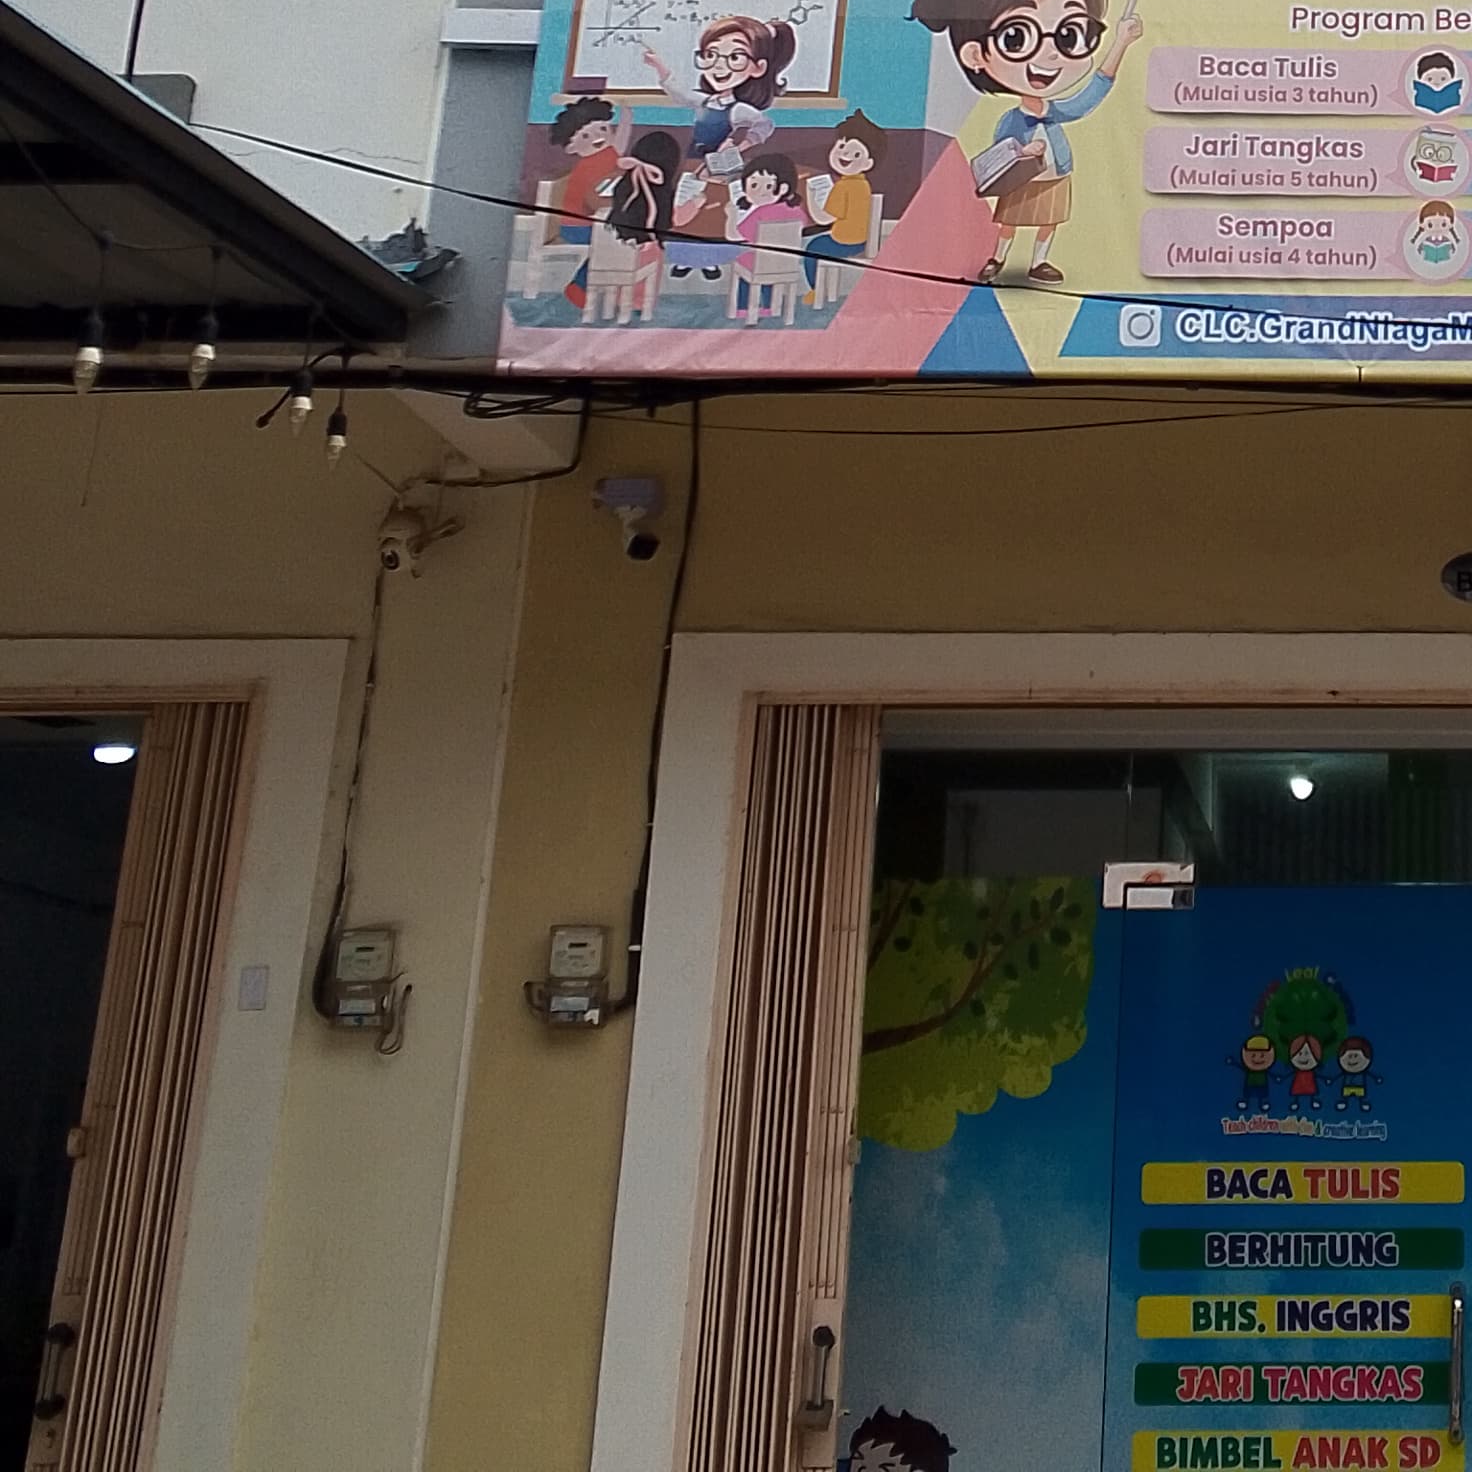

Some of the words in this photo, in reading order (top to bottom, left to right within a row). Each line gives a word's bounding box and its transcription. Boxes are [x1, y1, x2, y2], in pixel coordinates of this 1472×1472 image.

[1291, 6, 1426, 37] Program
[1199, 56, 1268, 79] Baca
[1274, 56, 1338, 79] Tulis
[1173, 84, 1239, 106] (Mulai
[1243, 86, 1287, 105] usia
[1291, 86, 1304, 104] 3
[1308, 84, 1378, 108] tahun)
[1185, 134, 1239, 159] Jari
[1245, 136, 1364, 165] Tangkas
[1170, 166, 1237, 189] (Mulai
[1242, 168, 1286, 188] usia
[1290, 170, 1304, 188] 5
[1307, 168, 1378, 192] tahun)
[1217, 216, 1333, 240] Sempoa
[1166, 244, 1235, 267] (Mulai
[1239, 247, 1284, 266] usia
[1287, 248, 1302, 266] 4
[1305, 246, 1378, 270] tahun)
[1206, 1168, 1292, 1199] BACA
[1304, 1168, 1400, 1199] TULIS
[1204, 1232, 1399, 1267] BERHITUNG
[1191, 1300, 1266, 1333] BHS.
[1276, 1300, 1410, 1331] INGGRIS
[1176, 1366, 1253, 1401] JARI
[1260, 1366, 1423, 1402] TANGKAS
[1155, 1435, 1281, 1470] BIMBEL
[1291, 1435, 1394, 1470] ANAK
[1399, 1436, 1441, 1470] SD
